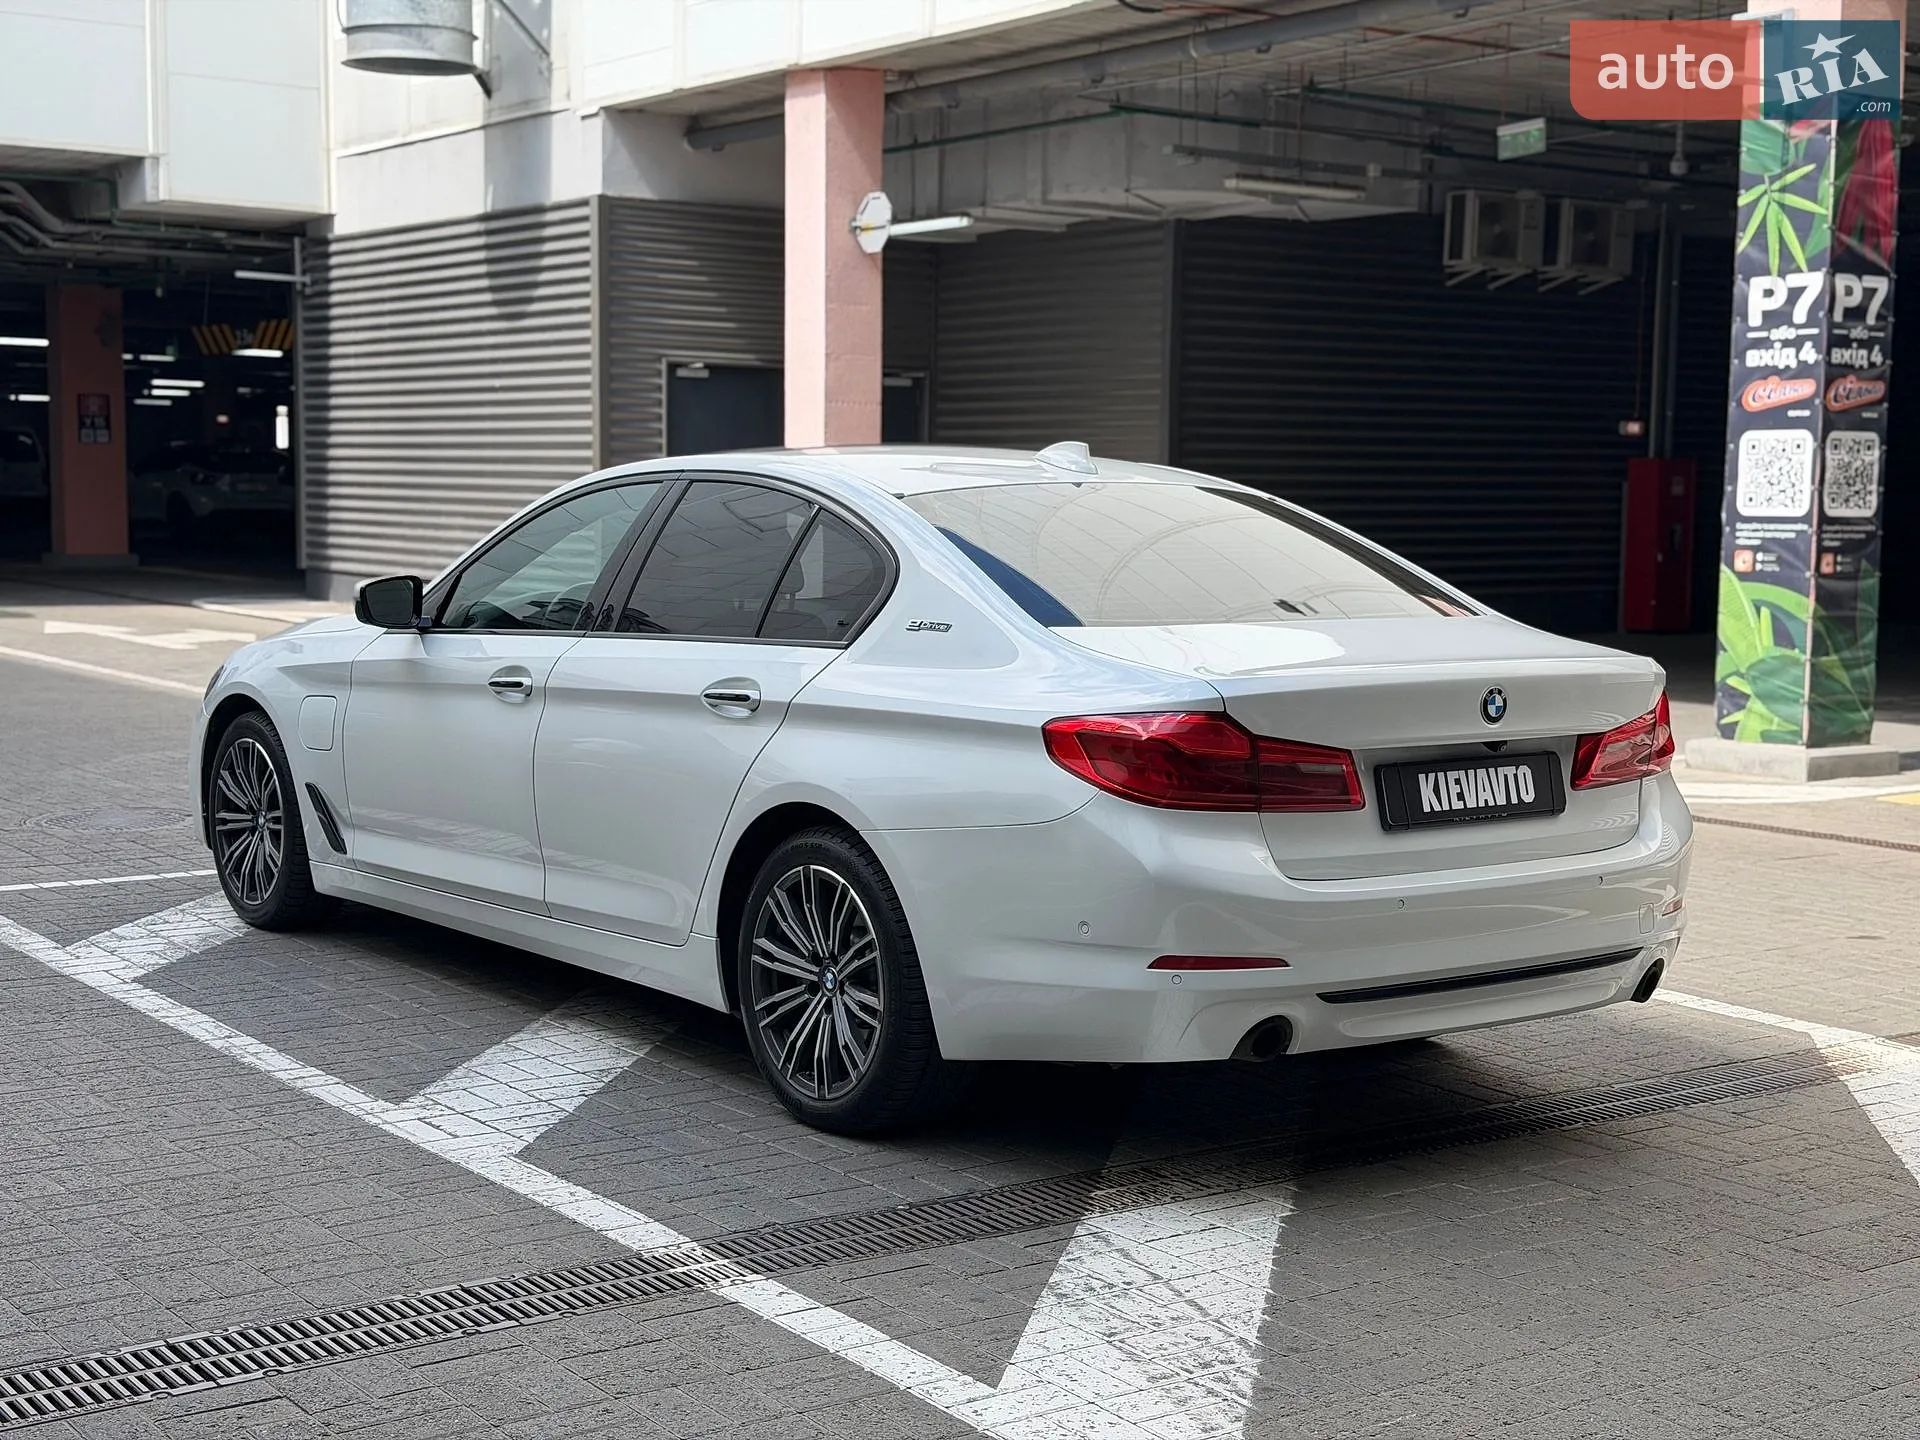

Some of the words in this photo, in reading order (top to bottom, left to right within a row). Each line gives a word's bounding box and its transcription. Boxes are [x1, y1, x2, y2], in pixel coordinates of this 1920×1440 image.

[1748, 271, 1825, 328] P7
[1832, 272, 1889, 326] P7
[1769, 325, 1797, 341] або
[1745, 341, 1798, 369] вхід
[1798, 340, 1817, 365] 4
[1831, 342, 1868, 369] вхід
[1869, 344, 1884, 366] 4
[1417, 764, 1536, 813] KIEVAVTO
